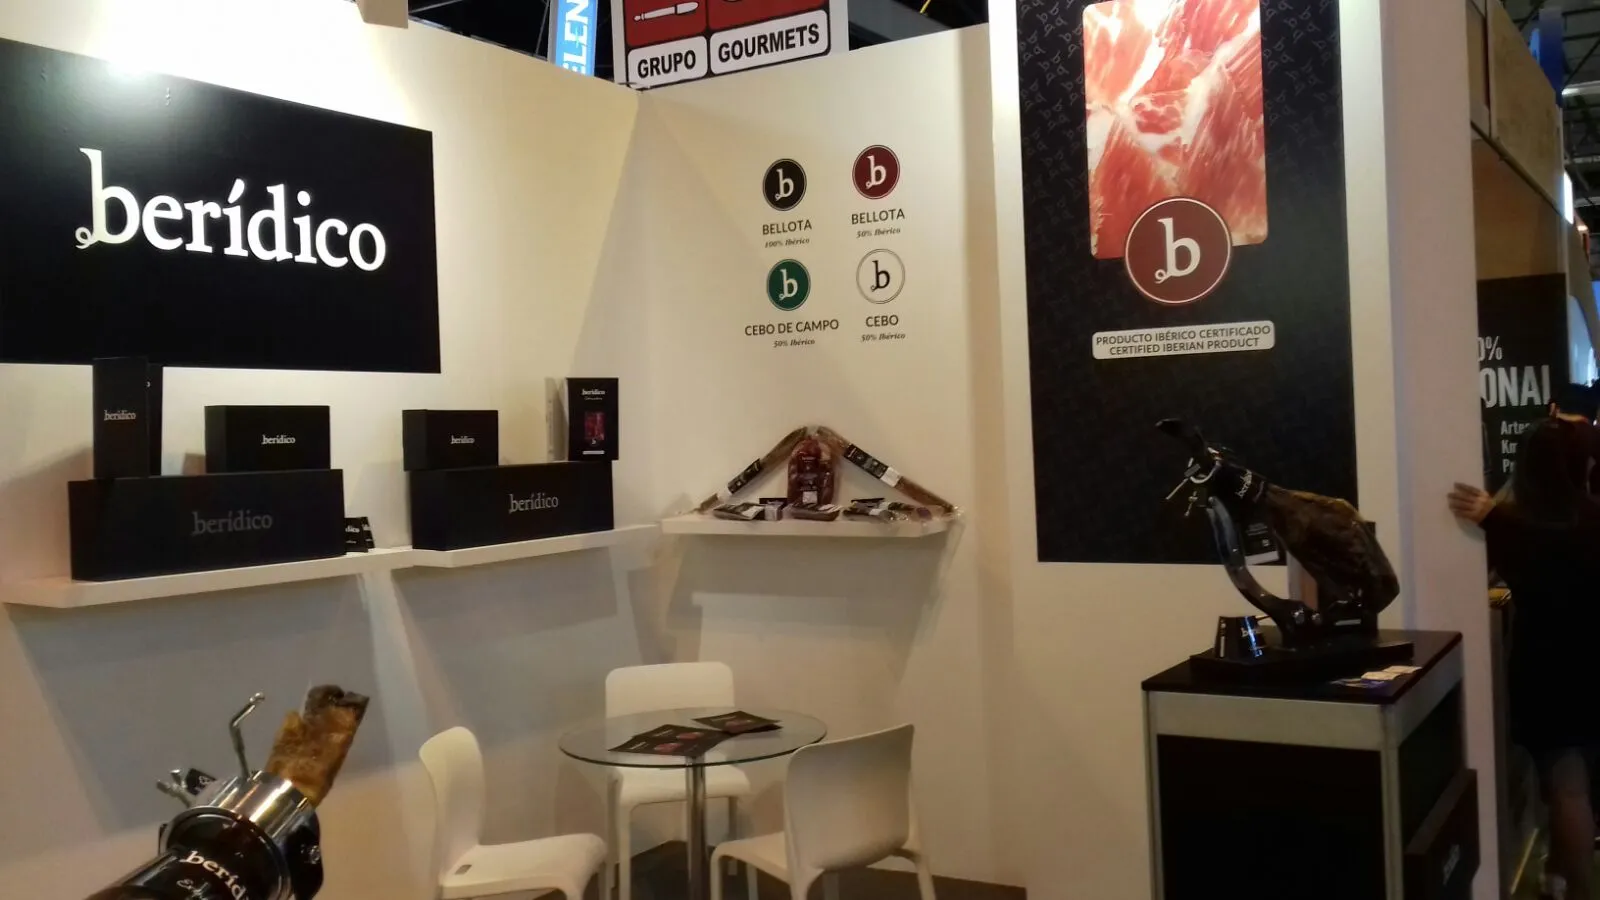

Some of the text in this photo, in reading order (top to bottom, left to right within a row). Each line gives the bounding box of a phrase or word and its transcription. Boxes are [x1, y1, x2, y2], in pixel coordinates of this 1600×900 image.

[718, 22, 820, 64] GOURMETS
[637, 49, 697, 79] GRUPO
[774, 168, 795, 202] b
[865, 154, 887, 190] b
[75, 147, 387, 272] berídico
[851, 208, 905, 225] BELLOTA
[762, 219, 813, 236] BELLOTA
[1154, 217, 1201, 284] b
[778, 268, 799, 301] b
[869, 260, 891, 293] b
[744, 318, 840, 337] CEBO DE CAMPO
[865, 314, 899, 328] CEBO
[1096, 325, 1272, 346] PRODUCTO IBÉRICO CERTIFICADO
[1109, 337, 1260, 356] CERTIFIED IBERIAN PRODUCT
[507, 492, 559, 515] berídico
[189, 509, 274, 537] berídico
